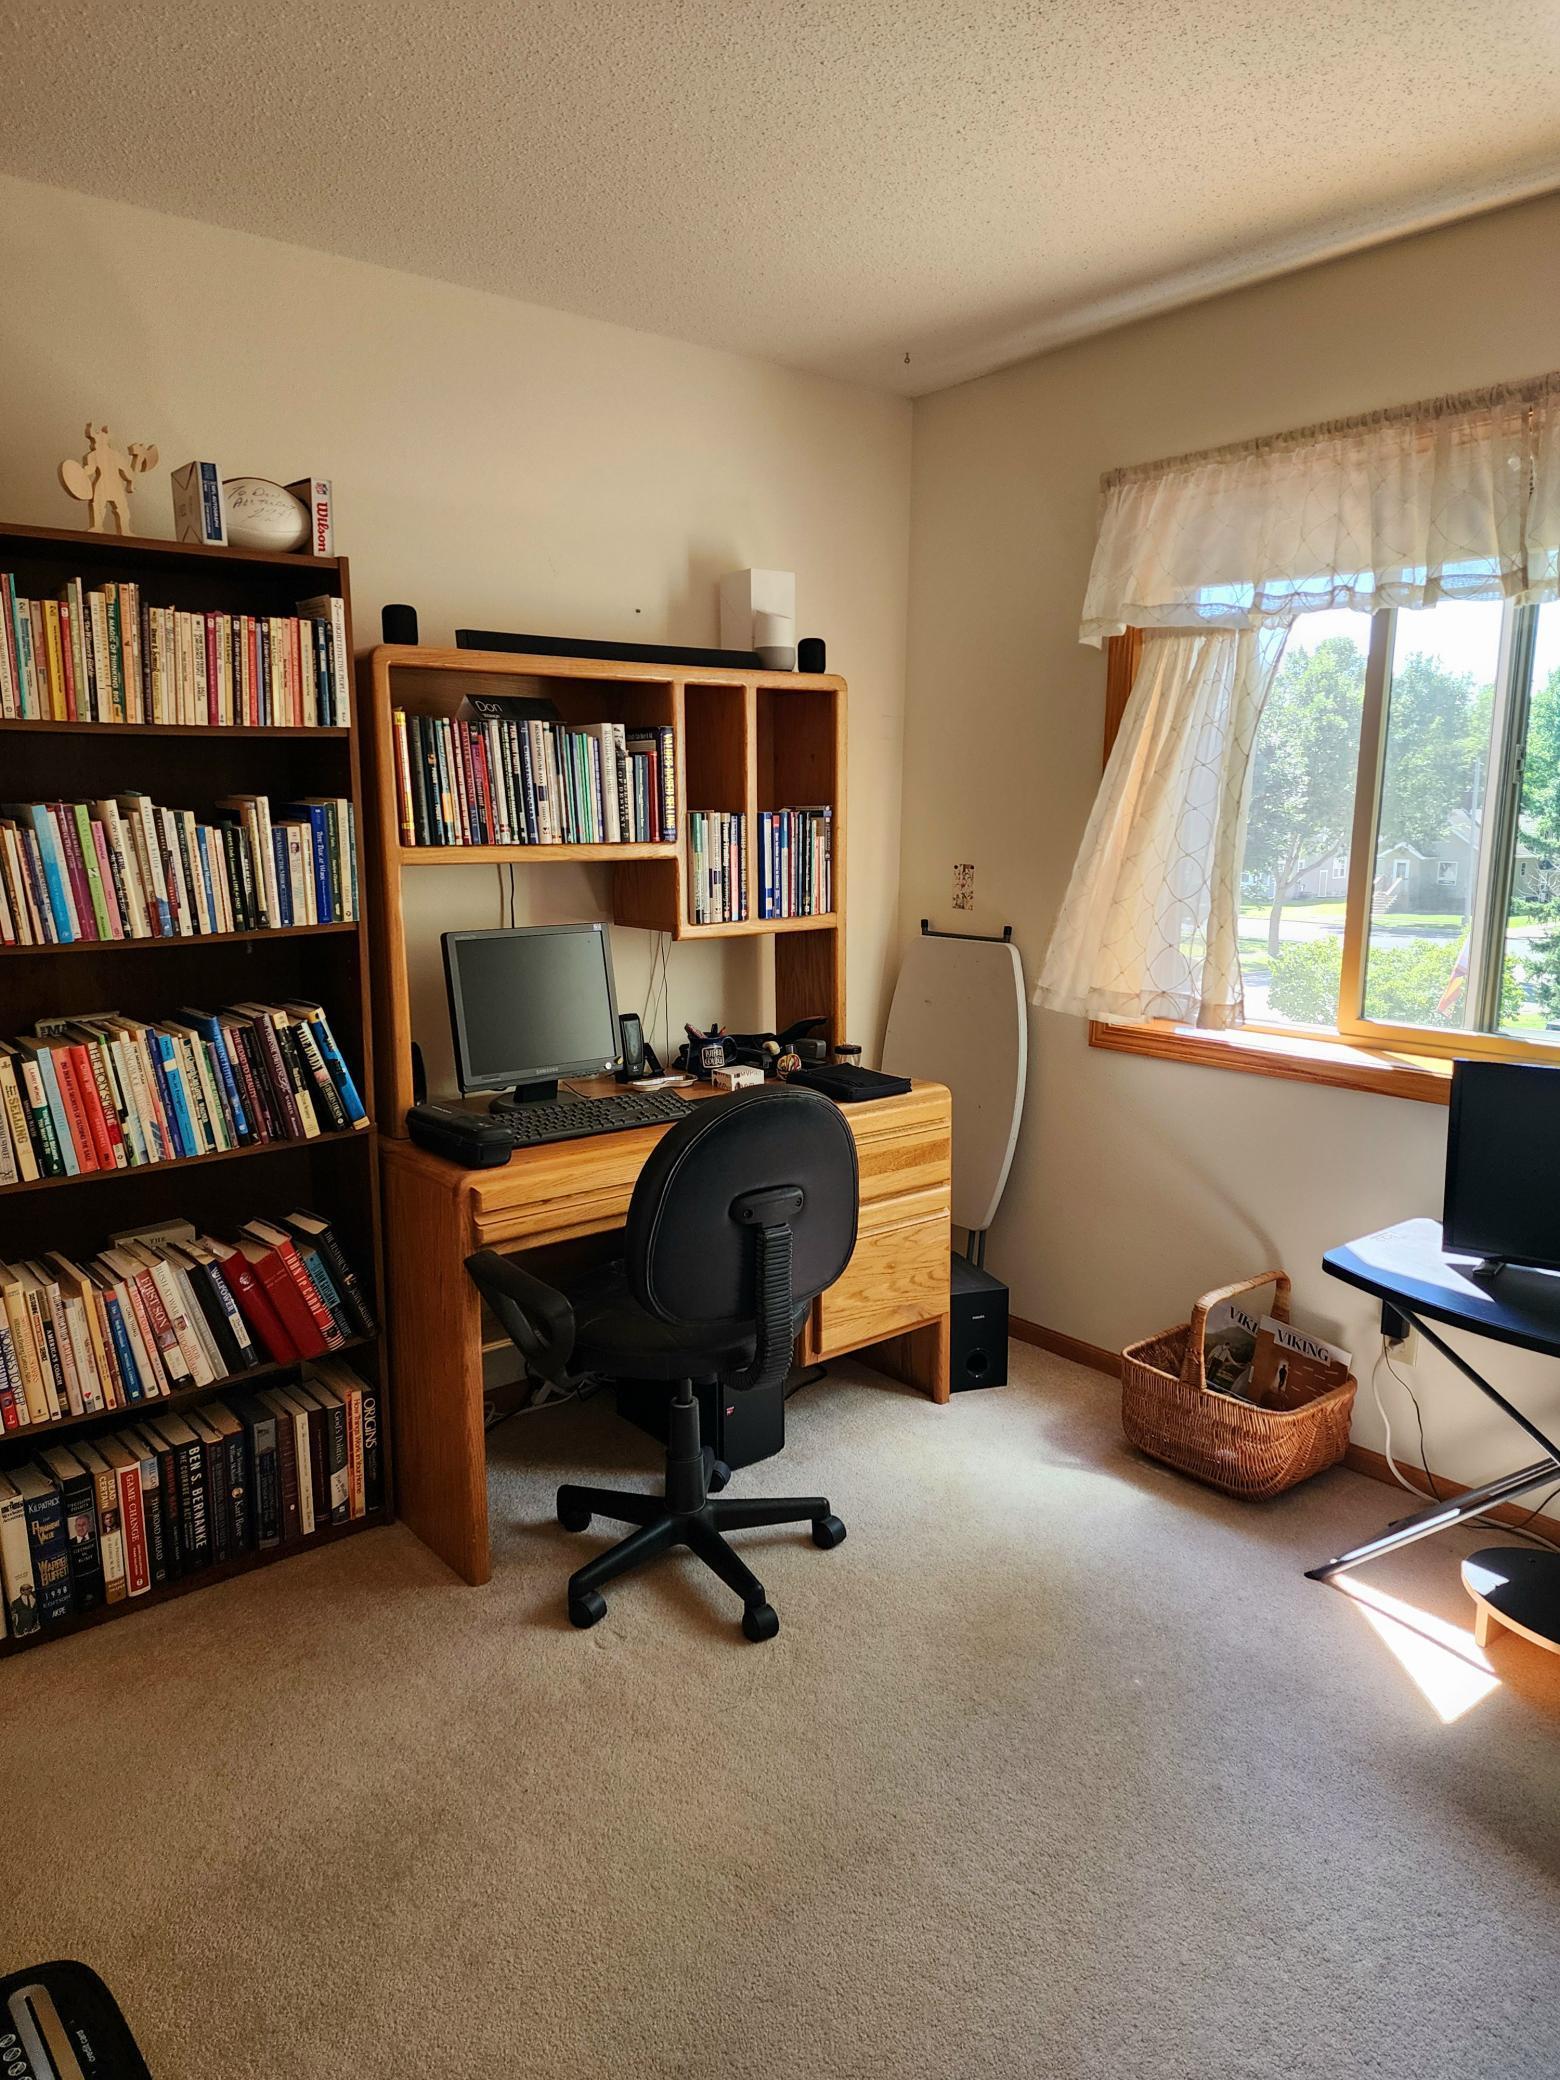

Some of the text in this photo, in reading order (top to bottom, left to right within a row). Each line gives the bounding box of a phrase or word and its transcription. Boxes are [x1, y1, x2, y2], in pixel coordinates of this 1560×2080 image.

[316, 502, 329, 552] Wilson
[110, 655, 118, 688] THINKING
[462, 732, 470, 759] MASTER
[467, 778, 475, 801] MONEY
[523, 745, 531, 788] CREATING
[663, 734, 675, 829] VALUES-BASED SELLING
[475, 778, 485, 806] Quadrant
[618, 786, 627, 828] DESTINY
[470, 810, 478, 827] BLUE
[89, 1047, 102, 1067] THE
[265, 1028, 277, 1052] PURPOSE
[272, 1053, 284, 1076] DRIVEN
[296, 1028, 312, 1049] THE
[303, 1046, 323, 1072] BODY
[93, 1065, 108, 1092] HOLY
[215, 1035, 234, 1087] PRESENT FUTURE
[233, 1031, 257, 1099] THE ROAD TO REALITY
[8, 1097, 28, 1144] SELLING
[100, 1094, 115, 1121] SPIRIT
[285, 1095, 295, 1114] WARREN
[324, 1231, 335, 1243] THE
[283, 1252, 304, 1277] JOHN
[140, 1276, 168, 1328] FIRST SON
[155, 1266, 180, 1316] BUSH AT WAR
[210, 1266, 236, 1313] WILLPOWER
[52, 1295, 69, 1341] COMMUNICATION
[46, 1329, 63, 1386] AMERICA'S COACH
[177, 1333, 201, 1377] WOODWARD
[1276, 1329, 1330, 1362] VIKING
[0, 1328, 27, 1407] PROMISES TO KEEP
[154, 1358, 164, 1381] WALKER
[352, 1416, 362, 1434] Things
[353, 1399, 361, 1414] How
[362, 1397, 379, 1449] ORIGINS
[334, 1411, 345, 1464] God's Politics
[28, 1496, 60, 1513] KILPATRICK
[98, 1476, 108, 1509] CERTAIN
[107, 1479, 116, 1500] DEAD
[179, 1451, 191, 1521] THE COURAGE TO ACT
[188, 1446, 210, 1549] BEN S. BERNANKE
[355, 1475, 364, 1494] Home
[125, 1474, 141, 1542] GAME CHANGE
[233, 1500, 247, 1537] Karl Rove
[151, 1498, 164, 1561] THE ROAD AHEAD
[45, 1586, 67, 1600] 1998
